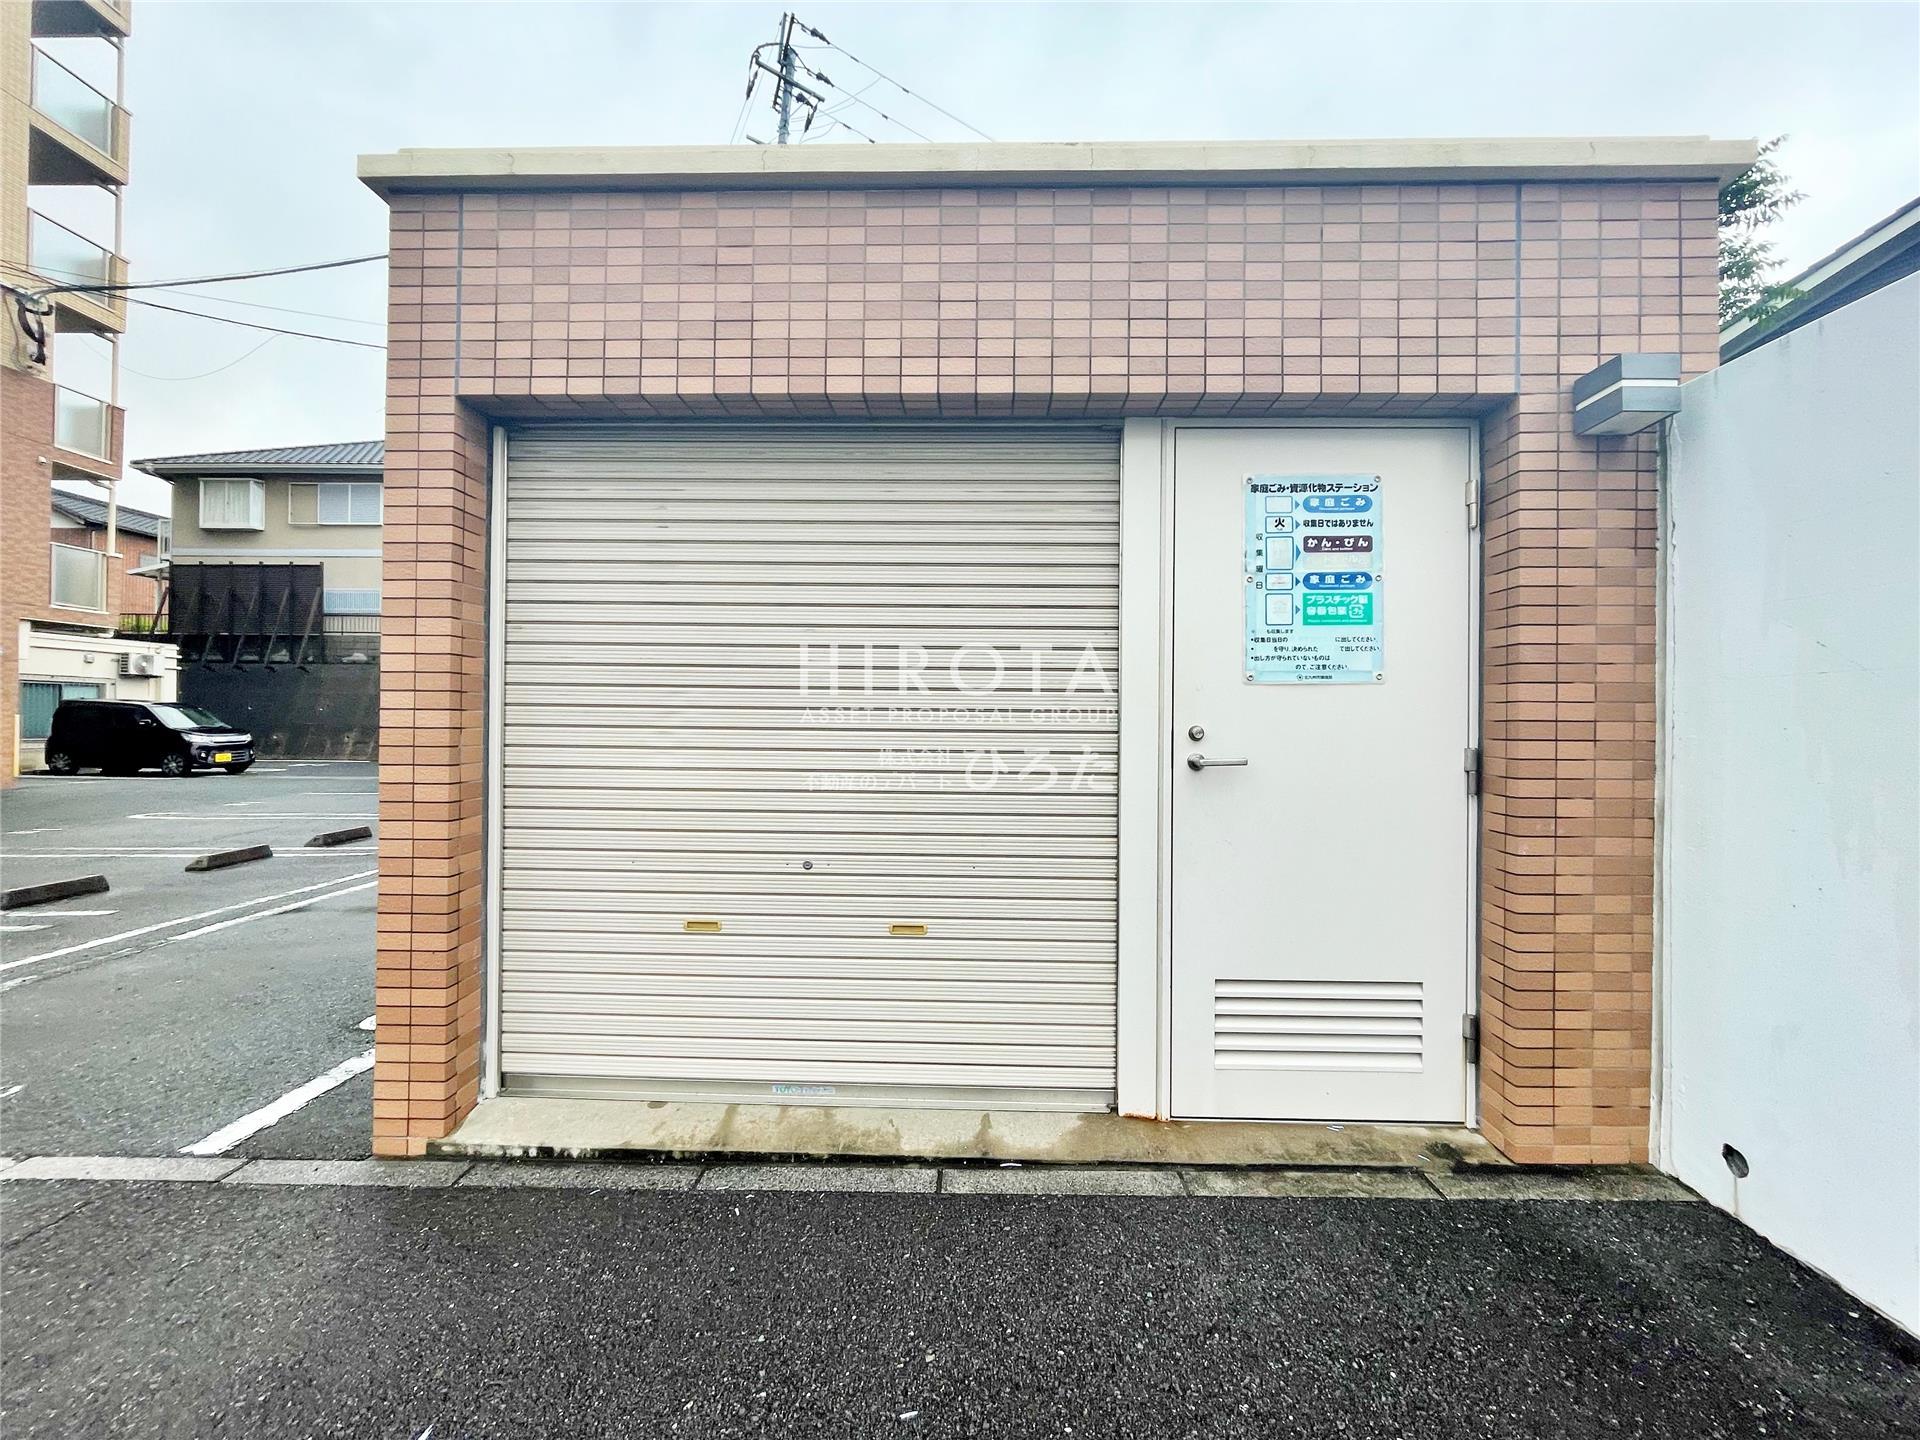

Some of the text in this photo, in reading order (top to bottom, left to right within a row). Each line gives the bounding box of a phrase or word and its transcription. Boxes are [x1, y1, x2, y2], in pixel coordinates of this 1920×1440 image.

[1250, 483, 1379, 494] 家庭ごみ・資源化物ステーション
[1274, 517, 1286, 528] 火
[1302, 519, 1374, 528] 収集日ではありません
[1306, 537, 1369, 548] かん・びん
